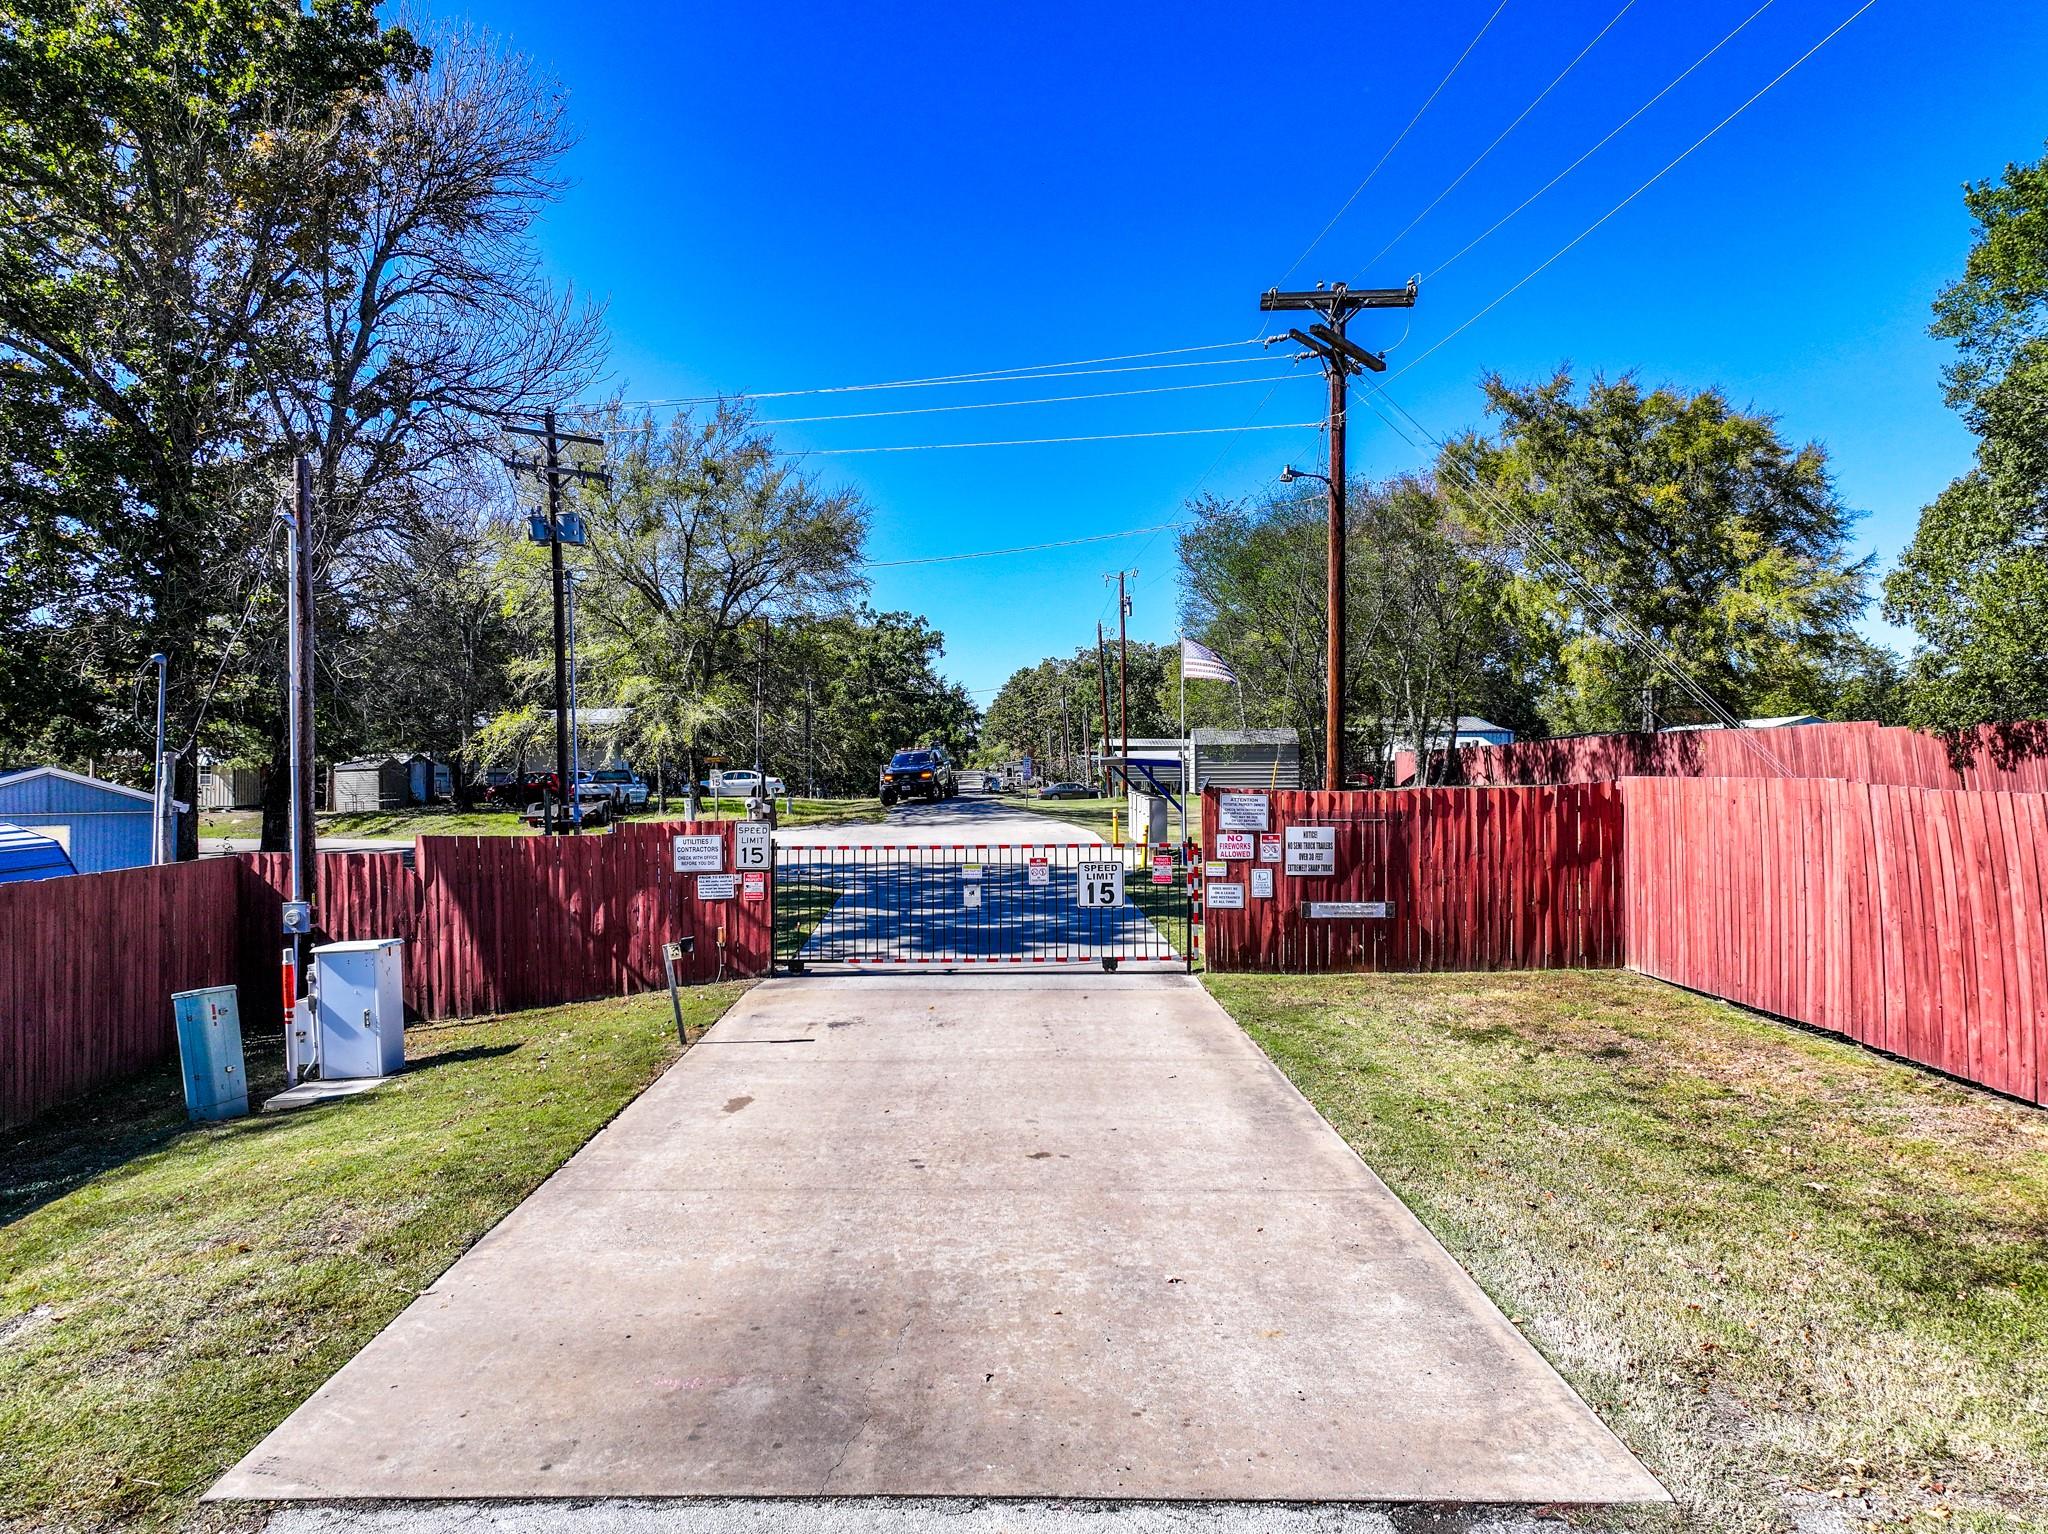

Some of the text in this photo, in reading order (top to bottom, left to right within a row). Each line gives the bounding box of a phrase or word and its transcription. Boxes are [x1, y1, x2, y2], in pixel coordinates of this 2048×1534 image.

[738, 826, 768, 834] SPEED
[741, 836, 764, 844] LIMIT
[1219, 842, 1251, 850] FIREWORKS
[1303, 841, 1315, 849] TRUCK
[1316, 841, 1333, 850] TRAILERS
[741, 847, 764, 864] 15
[1220, 850, 1251, 858] ALLOWED
[1083, 864, 1118, 872] SPEED
[1087, 882, 1115, 904] 15
